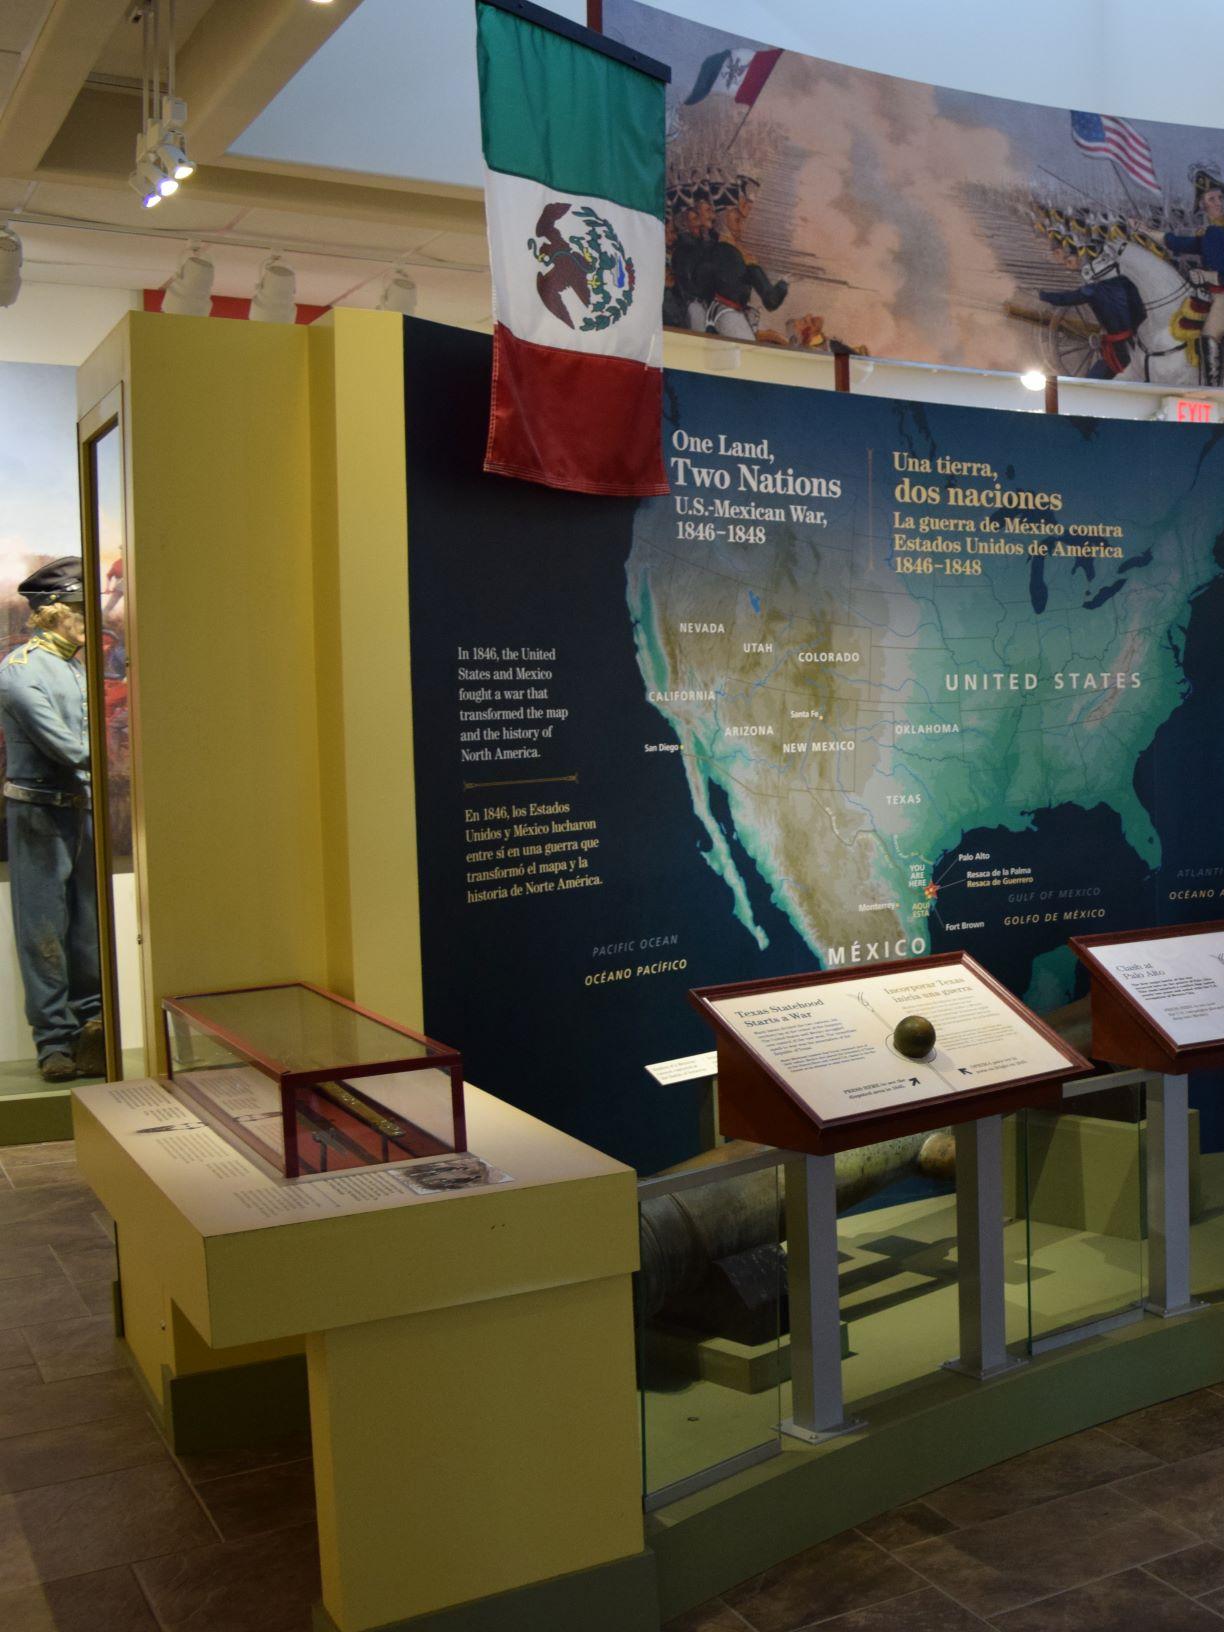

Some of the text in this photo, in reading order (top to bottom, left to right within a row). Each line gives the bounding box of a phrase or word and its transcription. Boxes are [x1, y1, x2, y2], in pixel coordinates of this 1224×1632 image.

[1177, 399, 1212, 423] EXIT
[672, 429, 774, 464] One Land,
[892, 452, 998, 480] Una tierra,
[671, 457, 841, 498] Two Nations
[895, 479, 1062, 511] dos naciones
[676, 496, 827, 525] U.S.-Mexican War,
[894, 512, 1123, 538] La guerra de México contra
[894, 535, 1123, 559] Estados Unidos de América
[680, 623, 725, 633] NEVADA
[458, 647, 556, 662] In 1846, the United
[743, 643, 773, 653] UTAH
[798, 652, 859, 662] COLORADO
[458, 668, 552, 680] States and Mexico
[946, 672, 1142, 691] UNITED STATES
[459, 688, 548, 702] fought a war that
[649, 691, 715, 701] CALIFORNIA
[460, 707, 568, 721] transformed the map
[790, 710, 819, 719] Santa Fe
[460, 726, 553, 741] and the history of
[725, 726, 774, 736] ARIZONA
[895, 724, 959, 734] OKLAHOMA
[461, 747, 540, 761] North America.
[645, 743, 678, 752] San Diego
[783, 740, 855, 753] NEW MEXICO
[886, 794, 921, 805] TEXAS
[464, 802, 570, 822] En 1846, los Estados
[465, 819, 596, 842] Unidos y México lucharon
[466, 837, 599, 862] entre sí en una guerra que
[467, 856, 588, 882] transformó el mapa y la
[1010, 867, 1031, 875] Palma
[467, 874, 603, 903] historia de Norte América.
[967, 880, 990, 888] Resaca
[1008, 888, 1101, 903] GULF OF MEXICO
[1169, 888, 1214, 900] OCÉANO
[858, 903, 895, 911] Monterrey
[1004, 908, 1105, 925] GOLFO DE MÉXICO
[946, 921, 984, 931] Fort Brown
[593, 934, 678, 958] PACIFIC OCEAN
[829, 938, 926, 966] MÉXICO
[584, 959, 688, 986] OCÉANO PACÍFICO
[735, 999, 824, 1018] Texas Statehood
[744, 1017, 780, 1027] Starts
[789, 1012, 812, 1020] War
